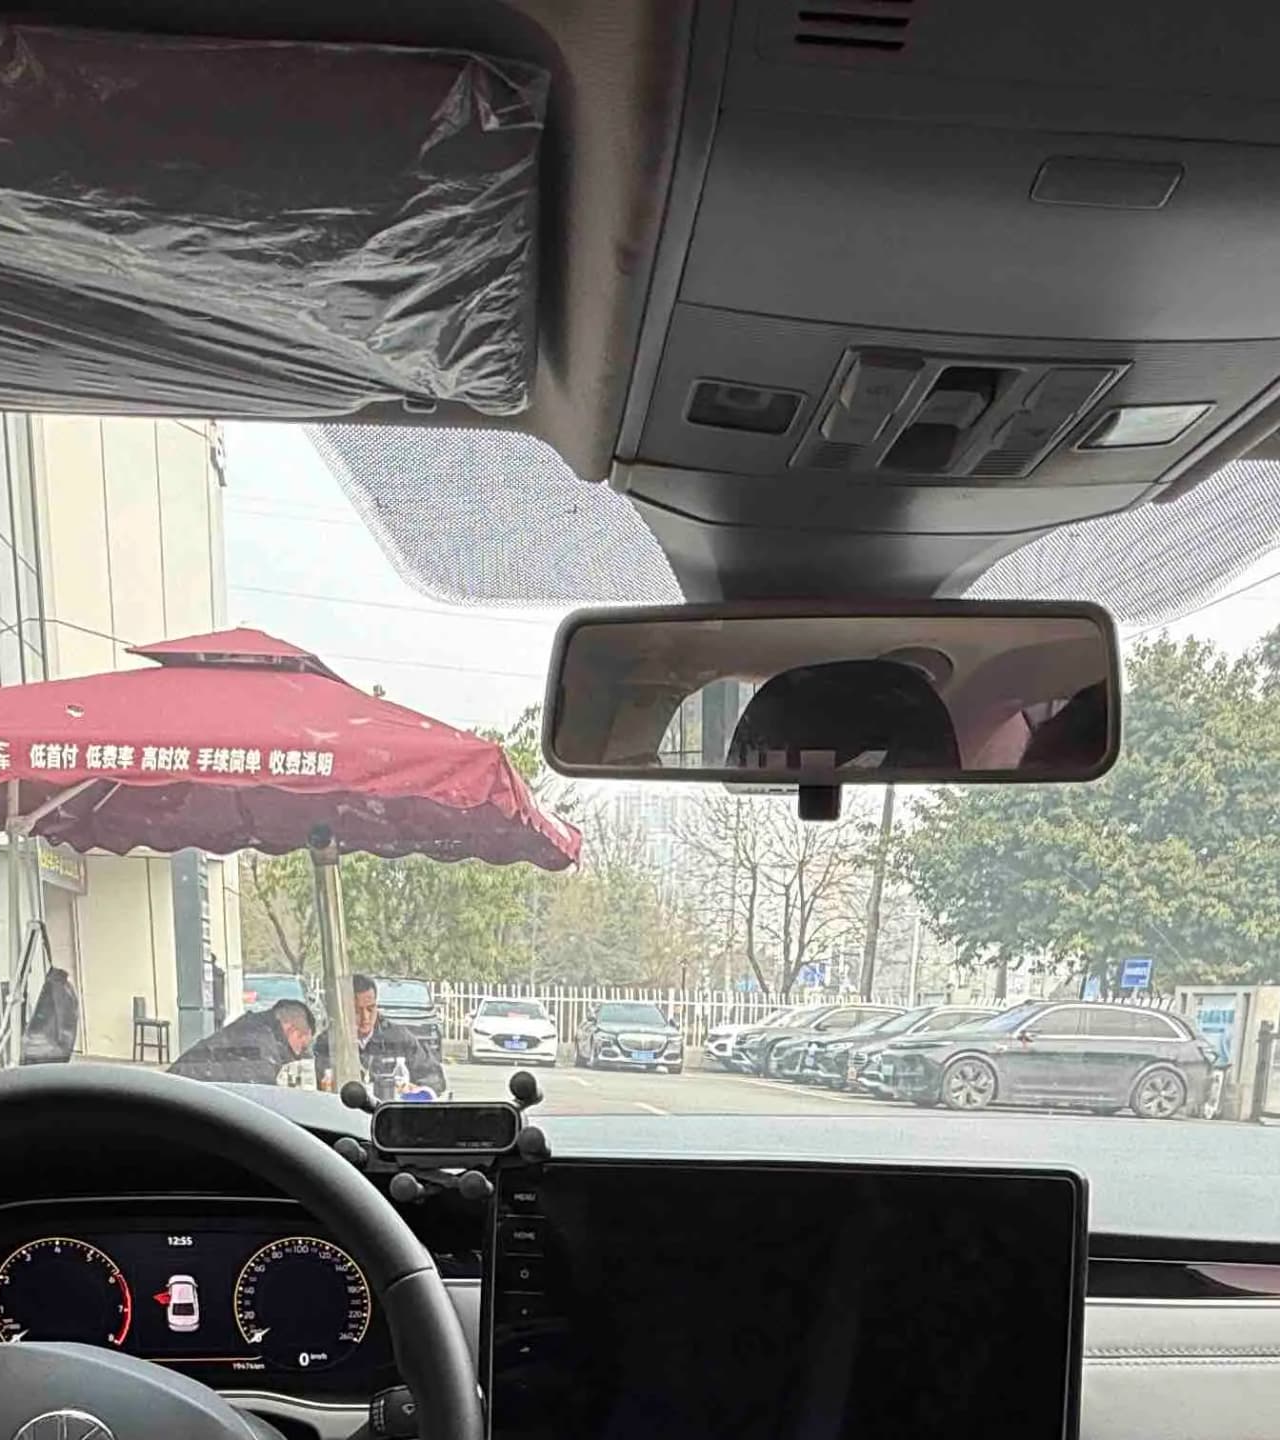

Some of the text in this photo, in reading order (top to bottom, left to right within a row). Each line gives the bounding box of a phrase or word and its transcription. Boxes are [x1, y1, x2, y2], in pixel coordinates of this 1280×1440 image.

[30, 743, 334, 776] 低首付 低费率 高时效 手续简单 收费透明
[167, 1236, 193, 1246] 12:55
[293, 1245, 309, 1254] 100
[243, 1311, 255, 1320] 20
[348, 1311, 362, 1319] 220
[299, 1352, 309, 1367] 0
